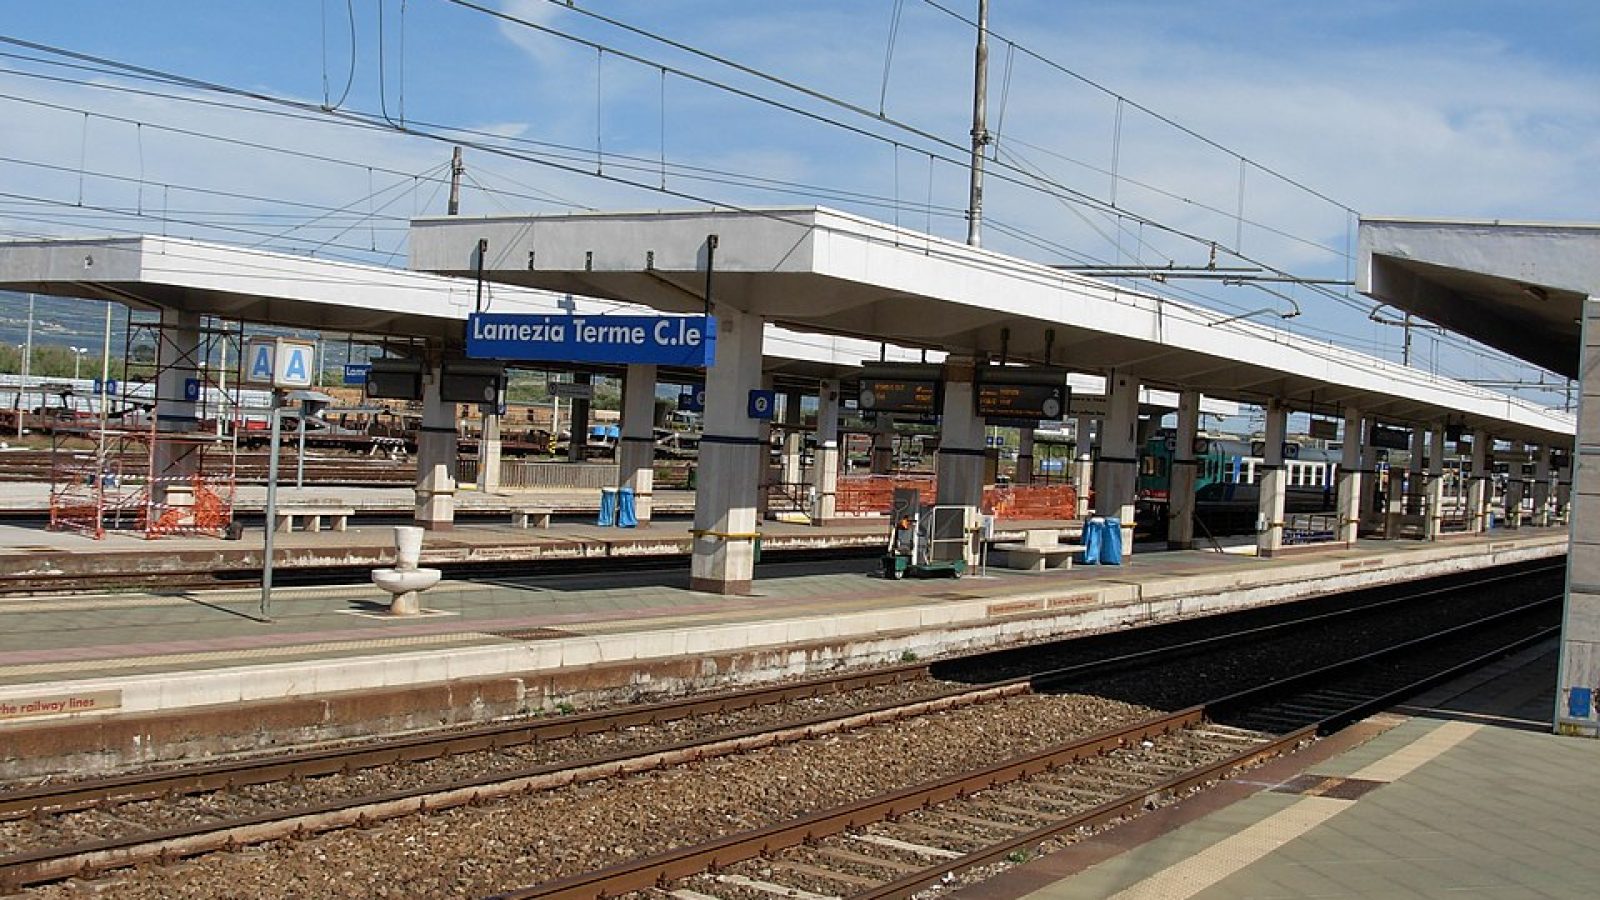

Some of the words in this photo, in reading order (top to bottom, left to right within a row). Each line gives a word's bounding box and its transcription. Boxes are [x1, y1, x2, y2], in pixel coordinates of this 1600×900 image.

[473, 317, 565, 342] Lamezia
[572, 319, 646, 345] Terme
[653, 319, 702, 347] C.le
[252, 346, 270, 376] A
[286, 349, 306, 379] A
[20, 700, 66, 712] railway
[69, 698, 95, 709] lines
